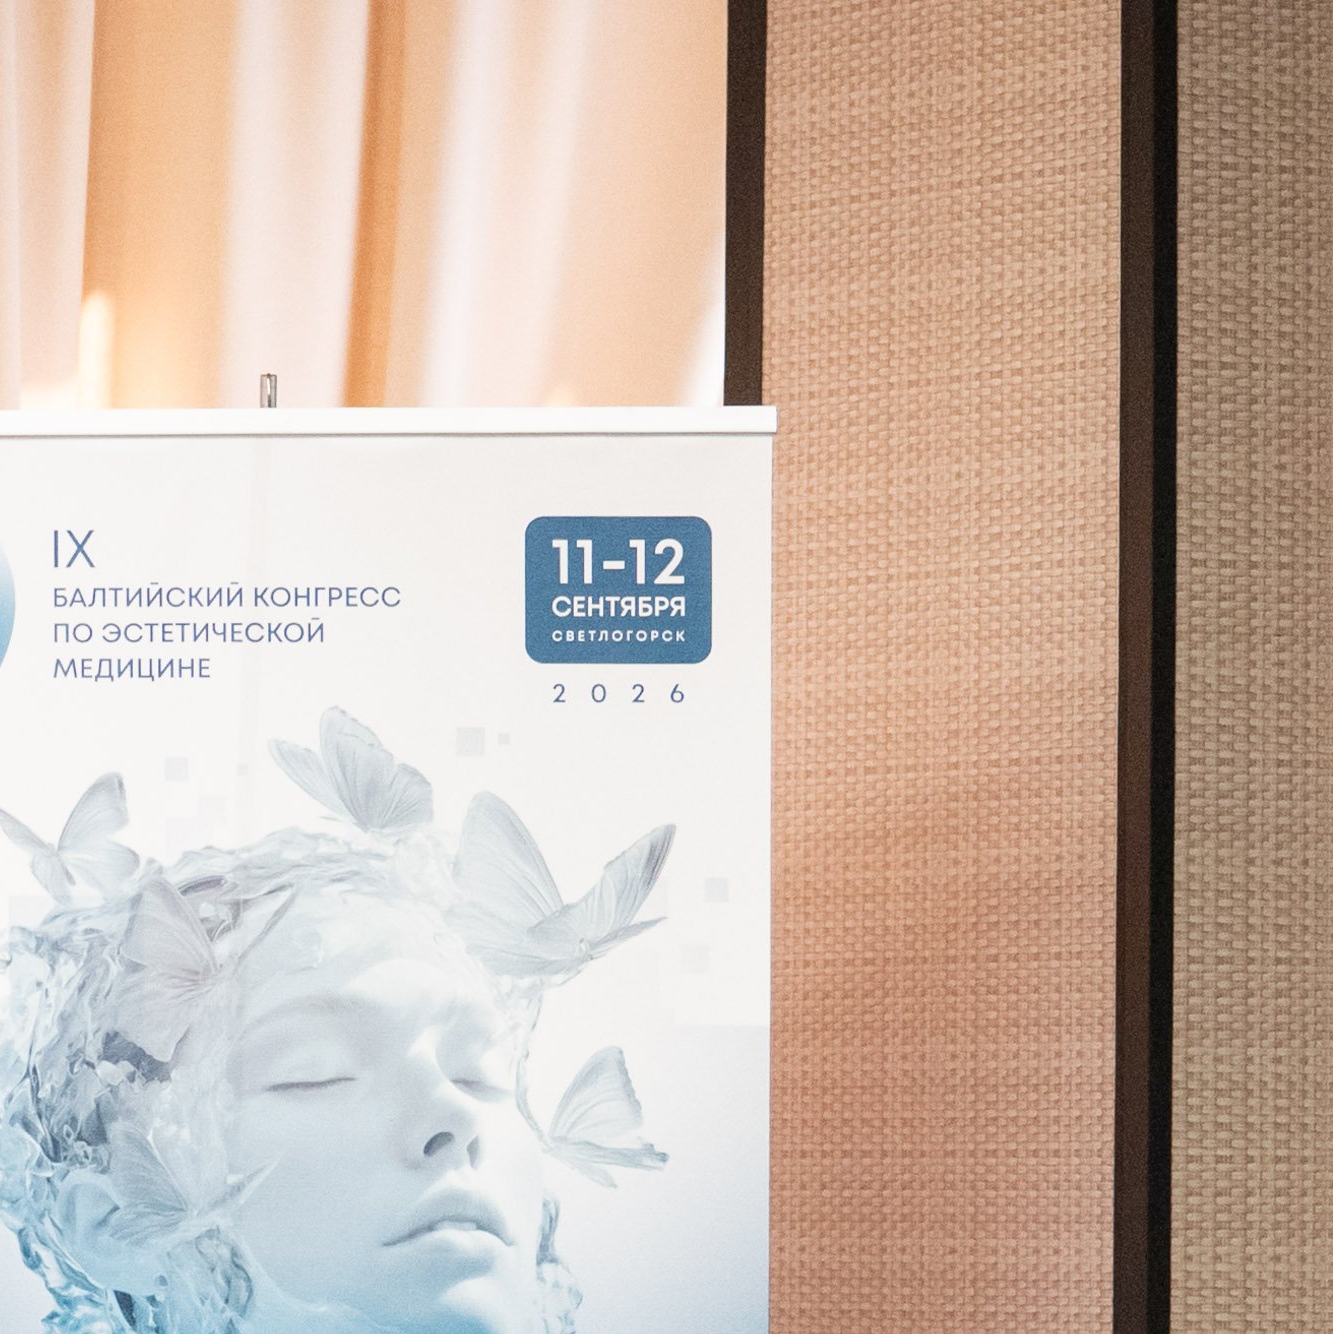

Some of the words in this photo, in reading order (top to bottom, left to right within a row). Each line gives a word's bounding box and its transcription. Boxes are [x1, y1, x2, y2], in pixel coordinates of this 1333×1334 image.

[53, 529, 95, 568] IX
[551, 538, 686, 585] 11-12
[53, 581, 243, 609] БАЛТИЙСКИЙ
[253, 587, 402, 609] КОНГРЕСС
[551, 595, 686, 620] СЕНТЯБРЯ
[53, 620, 94, 644] ПО
[102, 616, 324, 645] ЭСТЕТИЧЕСКОЙ
[551, 629, 686, 643] СВЕТЛОГОРСК
[53, 657, 211, 683] МЕДИЦИНЕ
